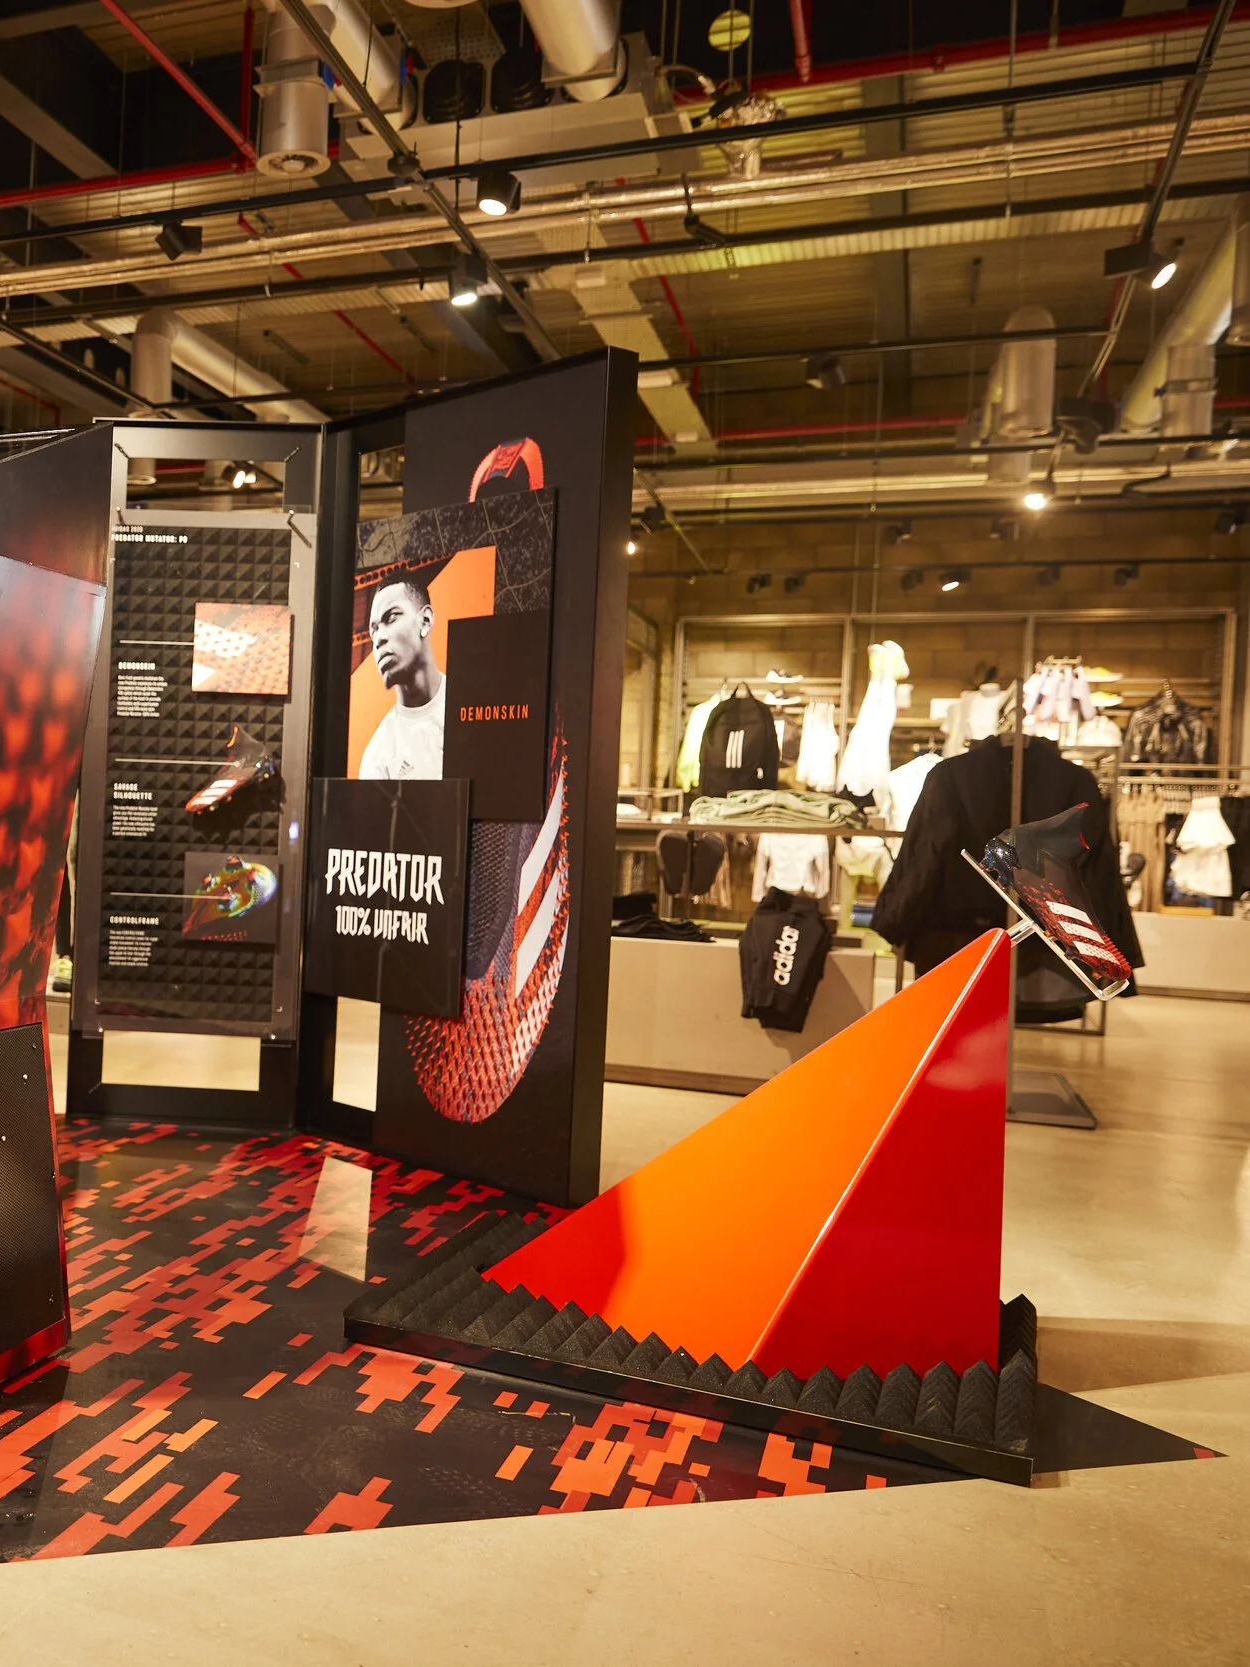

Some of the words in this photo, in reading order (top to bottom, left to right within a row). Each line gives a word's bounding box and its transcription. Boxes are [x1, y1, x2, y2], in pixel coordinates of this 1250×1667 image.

[460, 703, 529, 722] DEMONSKIN
[113, 791, 152, 800] SILHOUETTE
[325, 848, 445, 905] PREDATOR
[335, 905, 372, 936] 100%
[373, 909, 429, 945] UNFAIR
[772, 925, 800, 986] adidas
